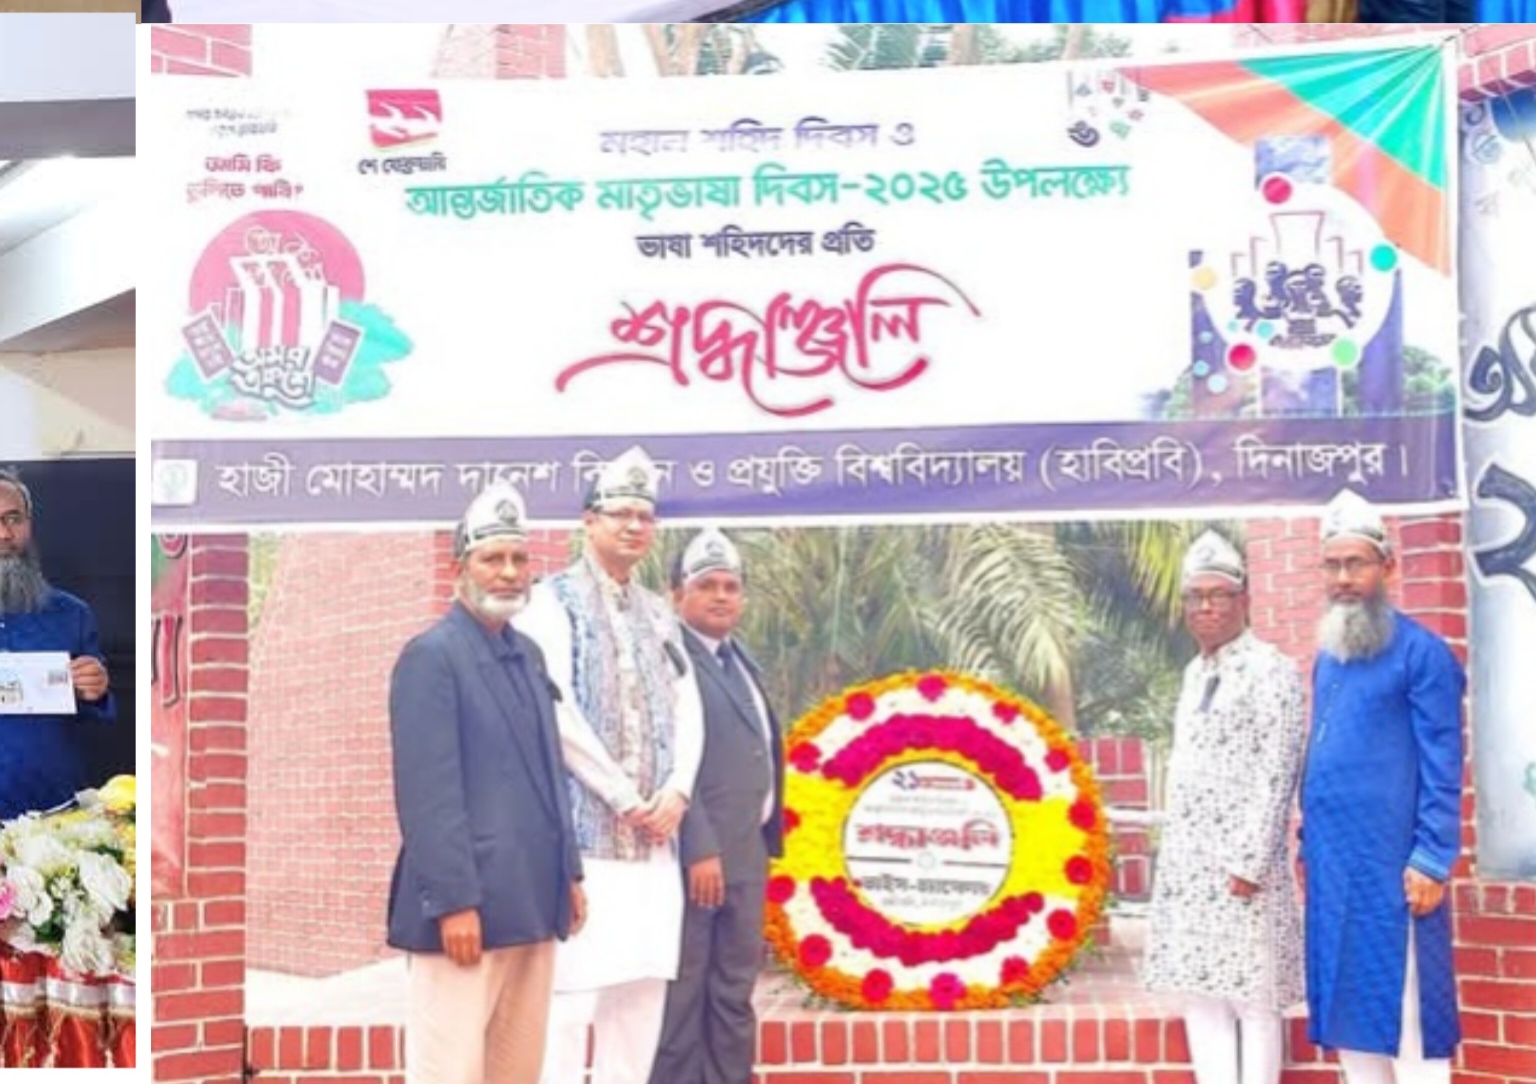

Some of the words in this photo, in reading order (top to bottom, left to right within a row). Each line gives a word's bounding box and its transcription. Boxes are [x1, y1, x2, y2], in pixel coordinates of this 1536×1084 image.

[599, 128, 691, 156] মহান
[701, 118, 783, 153] শহিদ
[794, 115, 879, 149] দিবস
[888, 121, 915, 147] ও
[404, 171, 586, 220] আন্তর্জাতিক
[596, 174, 742, 221] মাতৃভাষা
[752, 162, 969, 206] দিবস-২০২৫
[980, 157, 1133, 200] উপলক্ষ্যে
[635, 233, 693, 260] ভাষা
[701, 224, 815, 259] শহিদদের
[821, 220, 876, 256] প্রতি
[555, 263, 981, 417] শ্রদ্ধাঞ্জলি
[216, 452, 296, 498] হাজী
[306, 461, 446, 497] মোহাম্মদ
[689, 459, 715, 487] ও
[726, 445, 823, 496] প্রযুক্তি
[837, 443, 1027, 488] বিশ্ববিদ্যালয়
